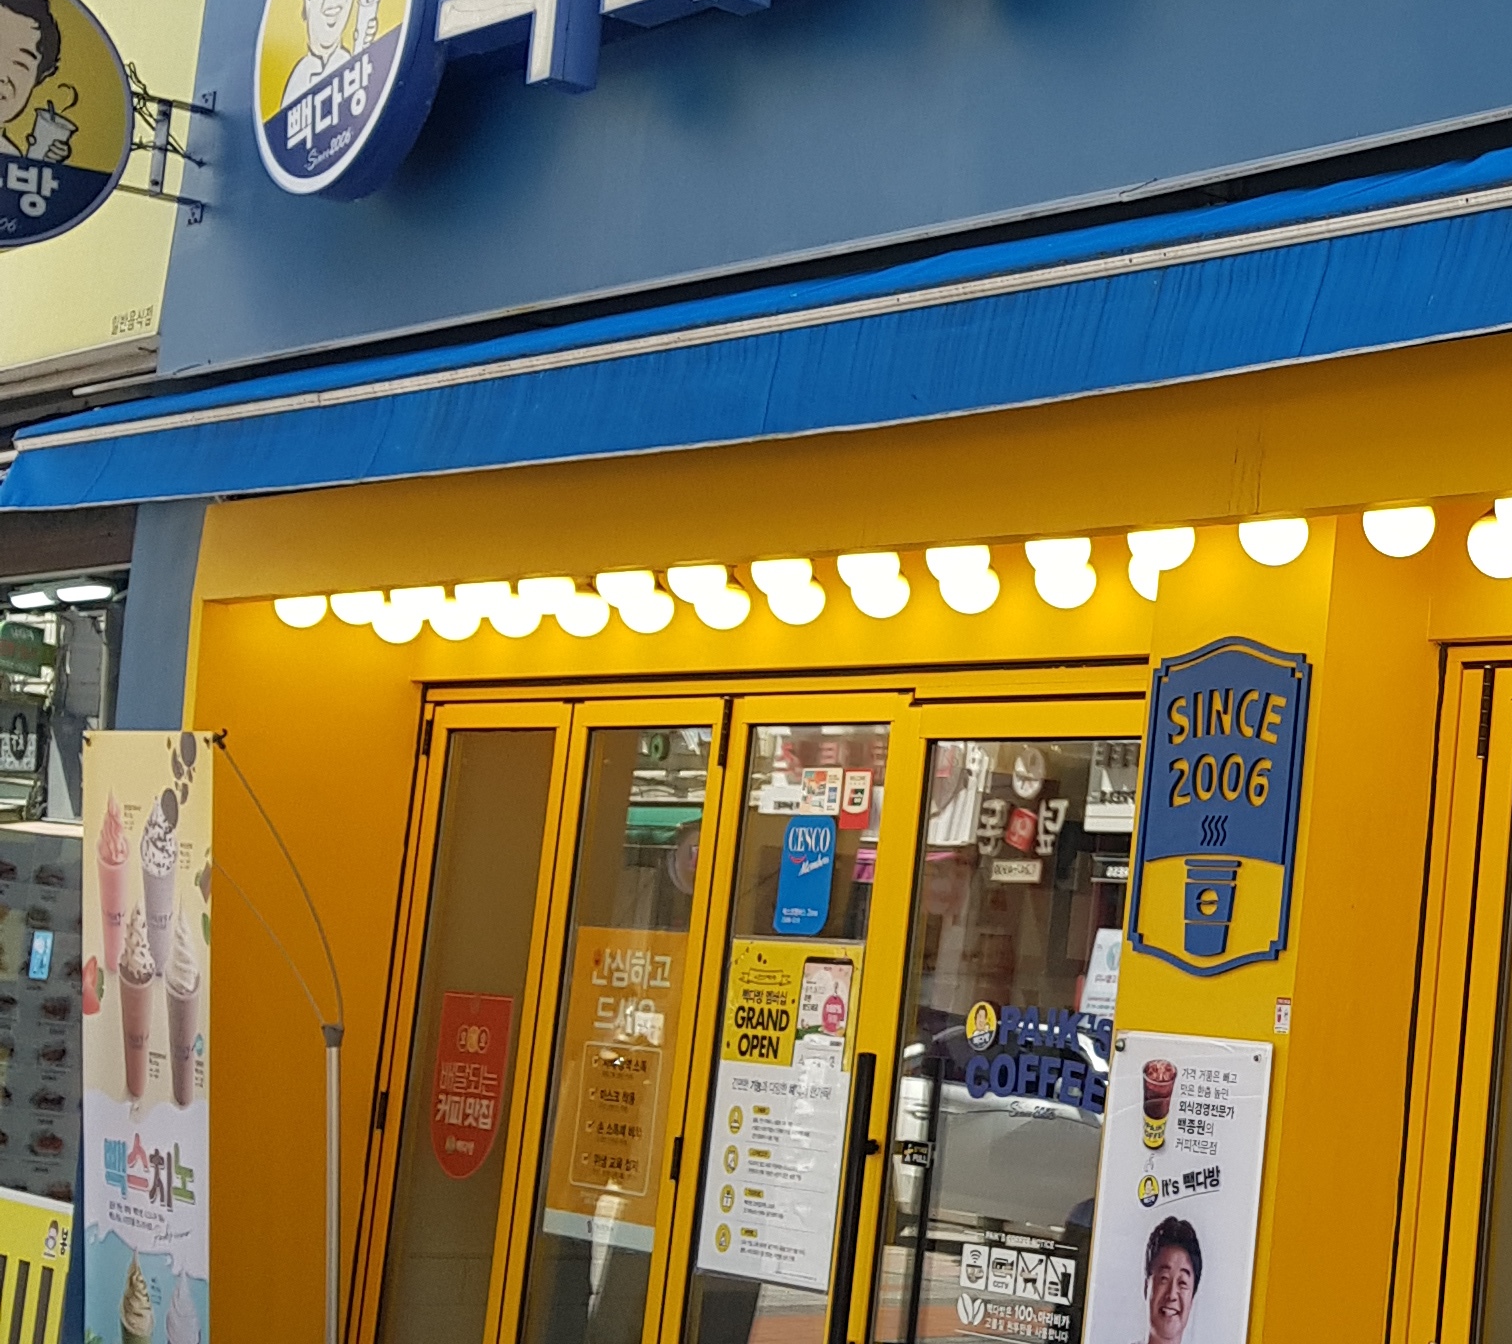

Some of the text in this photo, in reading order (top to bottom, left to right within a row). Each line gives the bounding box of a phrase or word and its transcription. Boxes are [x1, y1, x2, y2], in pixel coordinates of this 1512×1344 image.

[286, 53, 373, 150] 빽다방
[1166, 688, 1288, 746] SINCE
[1167, 752, 1274, 808] 2006
[787, 826, 831, 853] CESCO
[734, 1005, 790, 1032] GRAND
[1000, 1004, 1114, 1058] PAIK'S
[737, 1032, 780, 1059] OPEN
[965, 1053, 1108, 1115] COFFEE
[1181, 1068, 1197, 1081] 가격
[1178, 1100, 1235, 1120] 외식경영전문가
[1175, 1138, 1218, 1156] 커피전문점
[103, 1132, 197, 1213] 빽스치노
[1161, 1164, 1221, 1198] It's 빽다방
[992, 1280, 1009, 1291] CCTV
